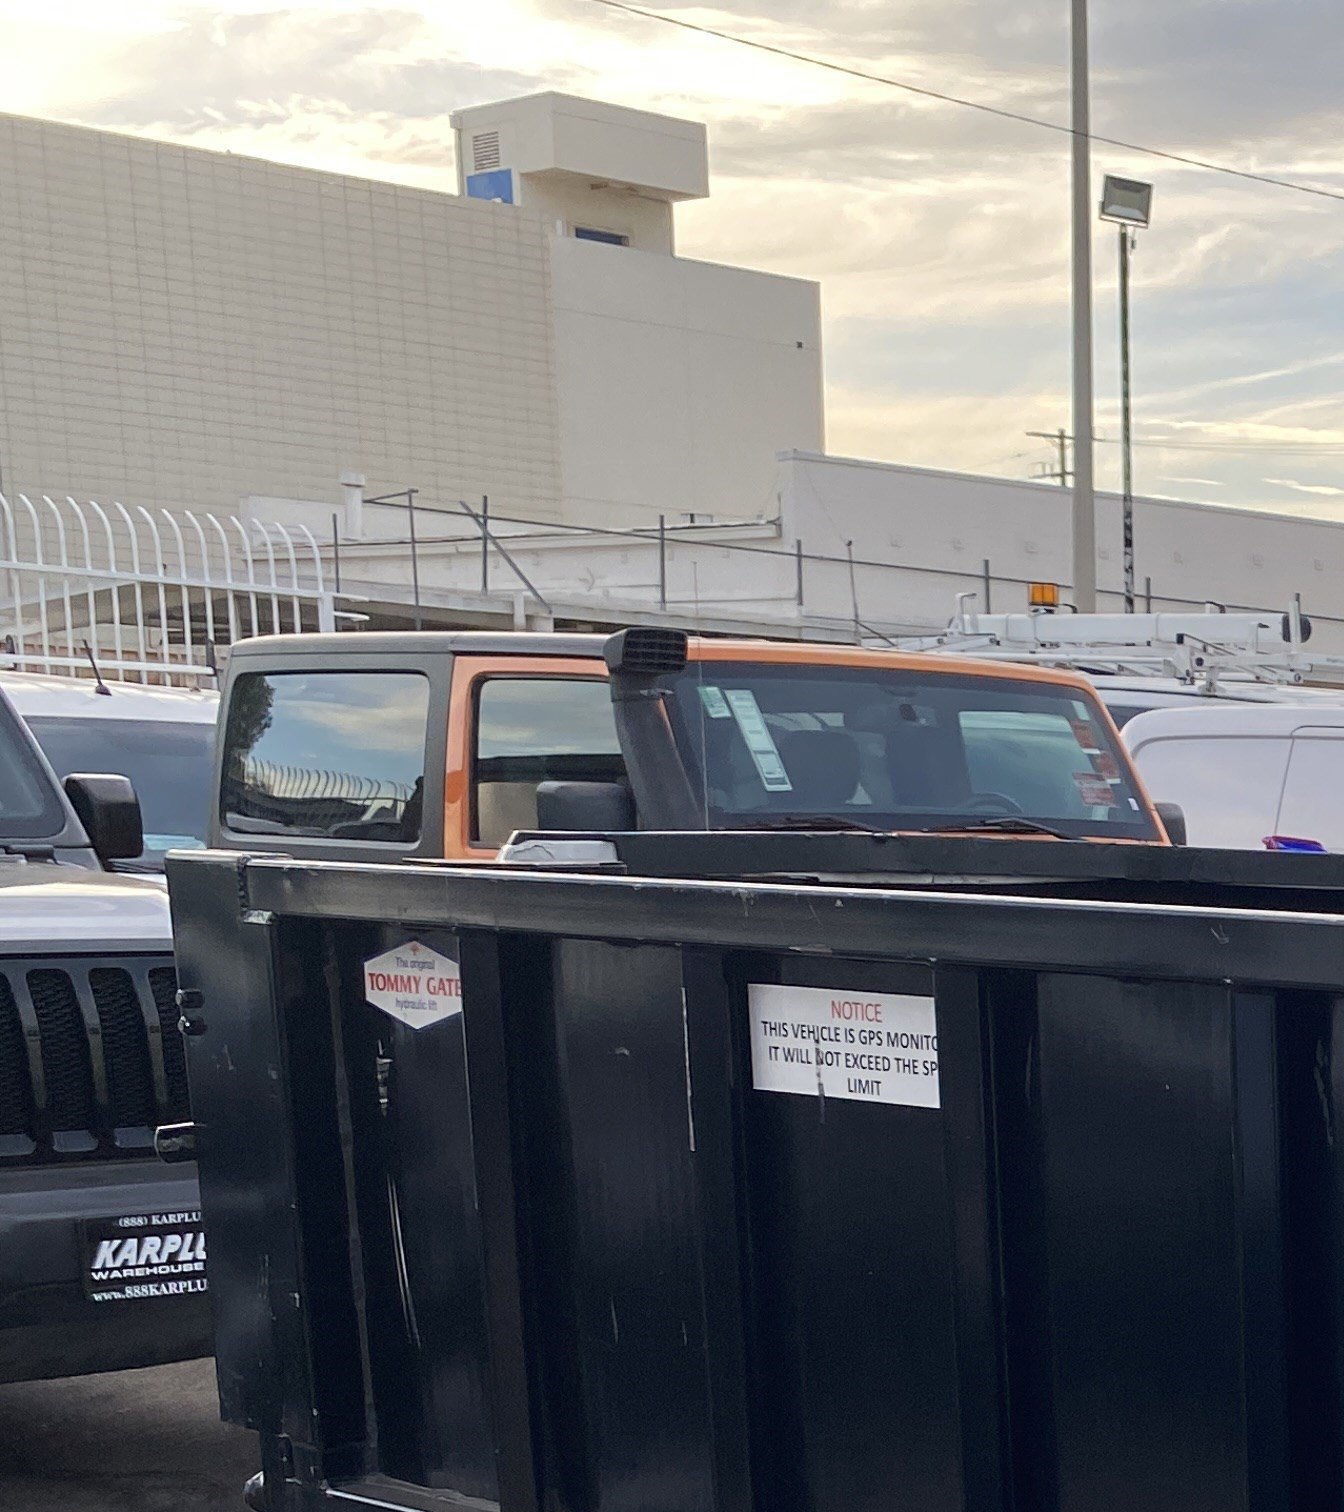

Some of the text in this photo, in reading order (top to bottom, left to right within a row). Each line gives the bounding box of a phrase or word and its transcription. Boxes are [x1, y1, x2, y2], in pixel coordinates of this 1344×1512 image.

[395, 957, 408, 968] The
[368, 972, 421, 994] TOMMY
[831, 1000, 883, 1023] NOTICE
[761, 1021, 788, 1038] THIS
[787, 1023, 841, 1044] VEHICLE
[844, 1028, 855, 1044] IS
[859, 1029, 883, 1046] GPS
[769, 1046, 780, 1061] IT
[782, 1047, 812, 1065] WILL
[815, 1048, 841, 1067] NOT
[845, 1053, 891, 1072] EXCEED
[894, 1057, 919, 1075] THE
[847, 1078, 882, 1096] LIMIT
[119, 1216, 148, 1227] (888)
[91, 1262, 204, 1281] WAREHOUSE
